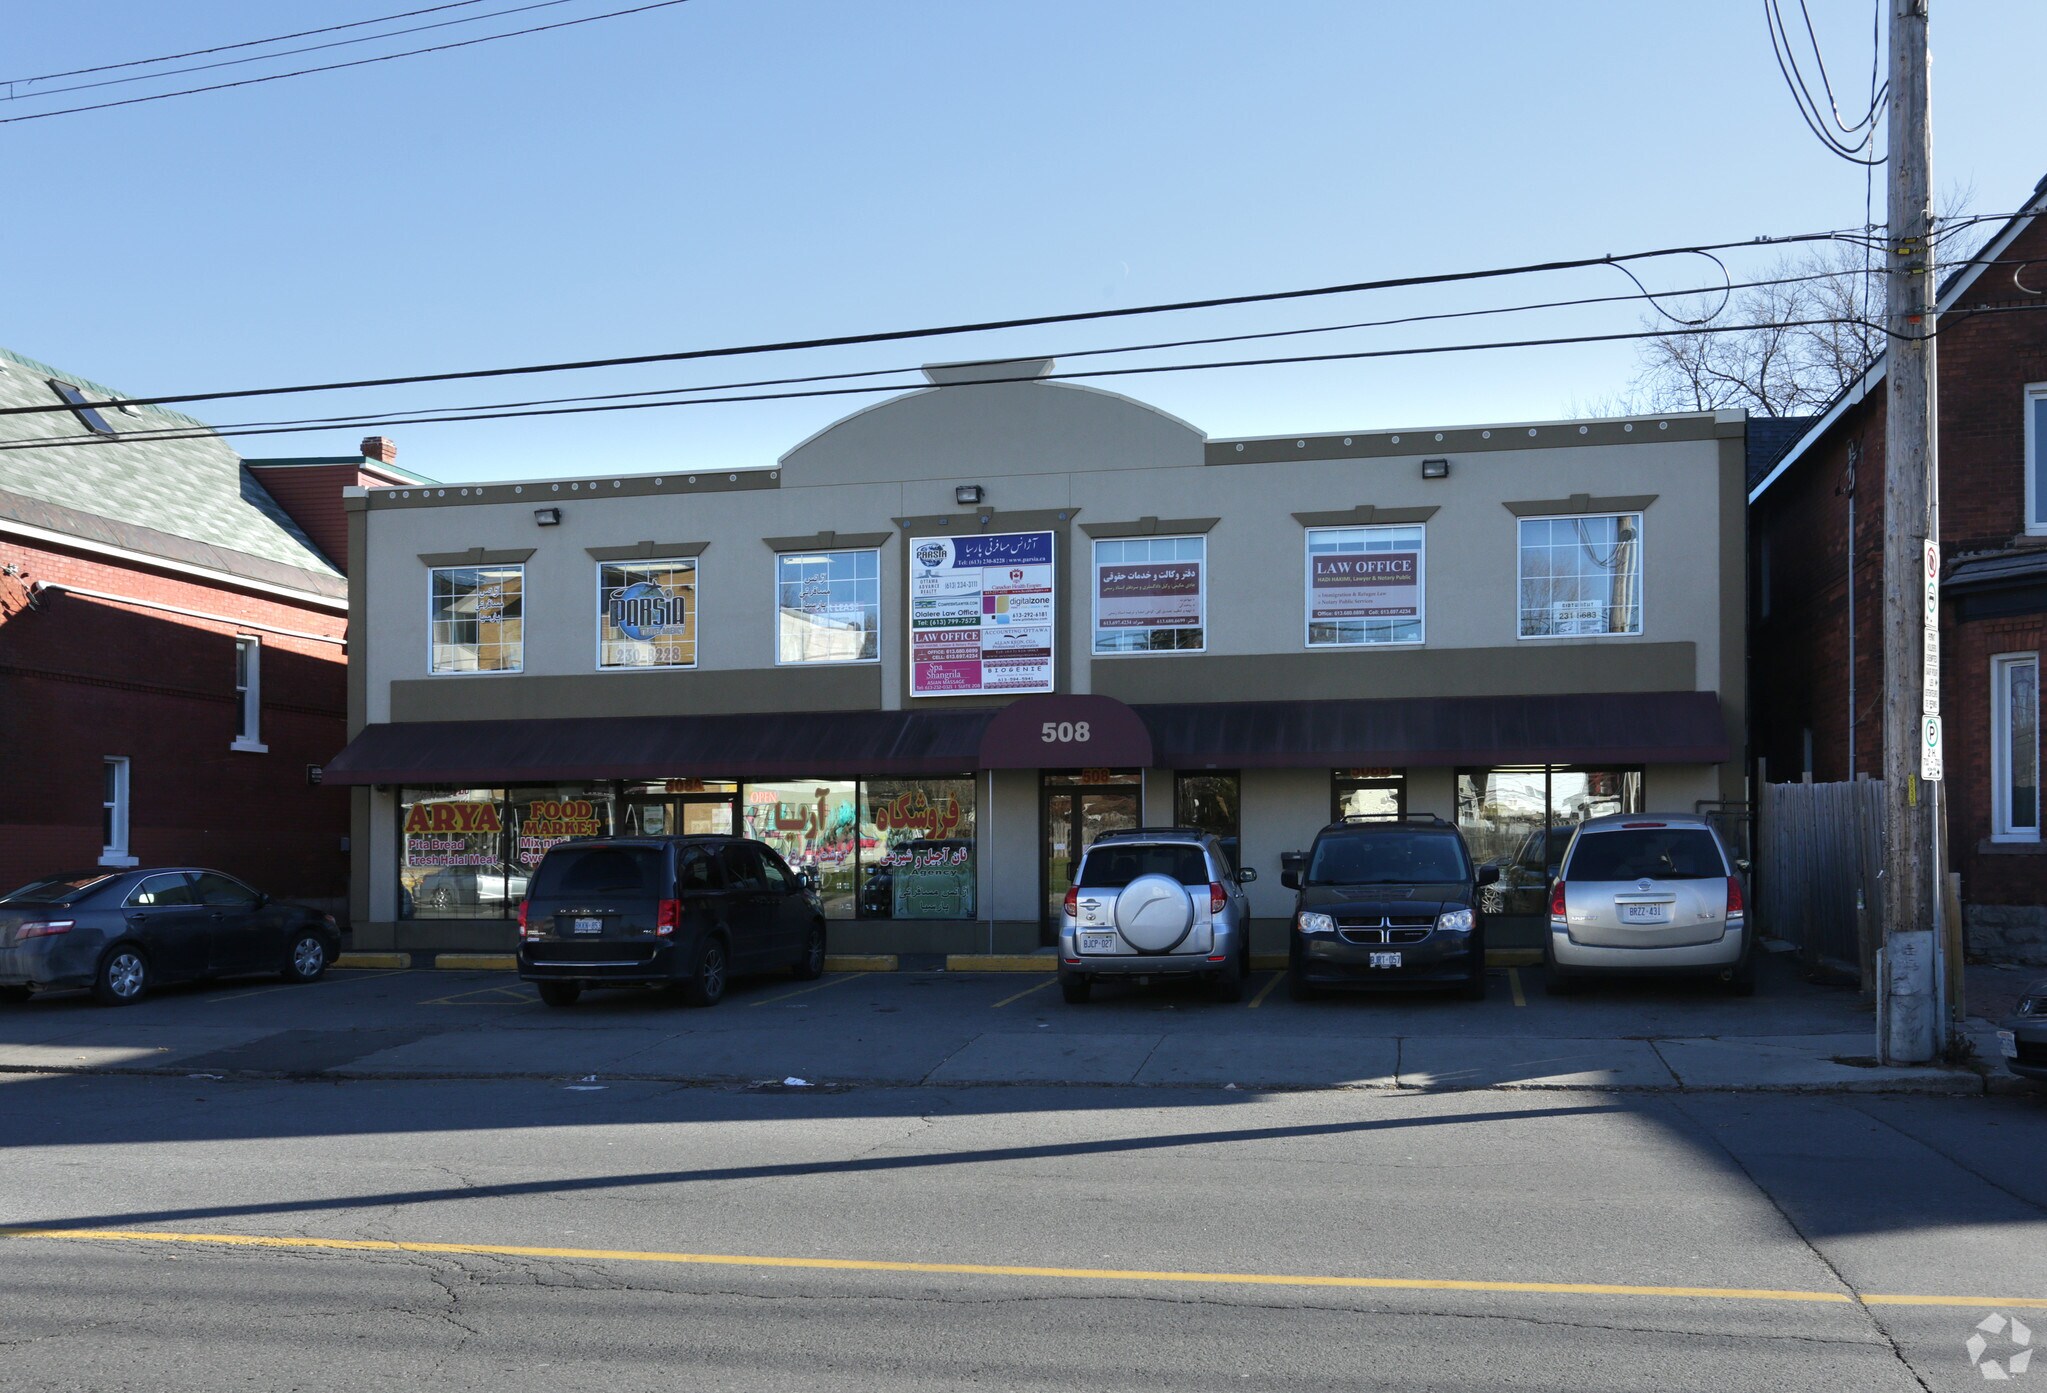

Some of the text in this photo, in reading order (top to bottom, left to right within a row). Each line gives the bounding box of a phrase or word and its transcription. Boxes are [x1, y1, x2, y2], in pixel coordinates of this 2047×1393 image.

[917, 549, 947, 559] PARSIA
[965, 544, 982, 558] پارسیا
[1317, 560, 1412, 574] LAW OFFICE
[1103, 571, 1126, 583] حقوقی
[1127, 571, 1152, 580] خدمات
[1158, 570, 1180, 580] وکالت
[1181, 569, 1196, 579] دفتر
[1010, 597, 1050, 606] digitalzone
[915, 631, 979, 642] LAW OFFICE
[929, 662, 944, 673] Spa
[926, 669, 962, 681] Shangrila
[1041, 721, 1090, 743] 508
[1082, 769, 1109, 784] 508
[750, 791, 777, 803] OPEN
[530, 800, 592, 820] FOOD
[775, 787, 830, 841] آریا
[876, 791, 960, 840] فروشگاه
[404, 803, 502, 834] ARYA
[522, 819, 601, 836] MARKET
[408, 839, 465, 850] Pita Bread
[520, 837, 541, 849] Mix
[408, 854, 498, 865] Fresh Halal Meat
[880, 848, 914, 866] شیرینی
[924, 847, 950, 865] آجیل
[951, 847, 968, 865] نان
[911, 869, 957, 877] Agency
